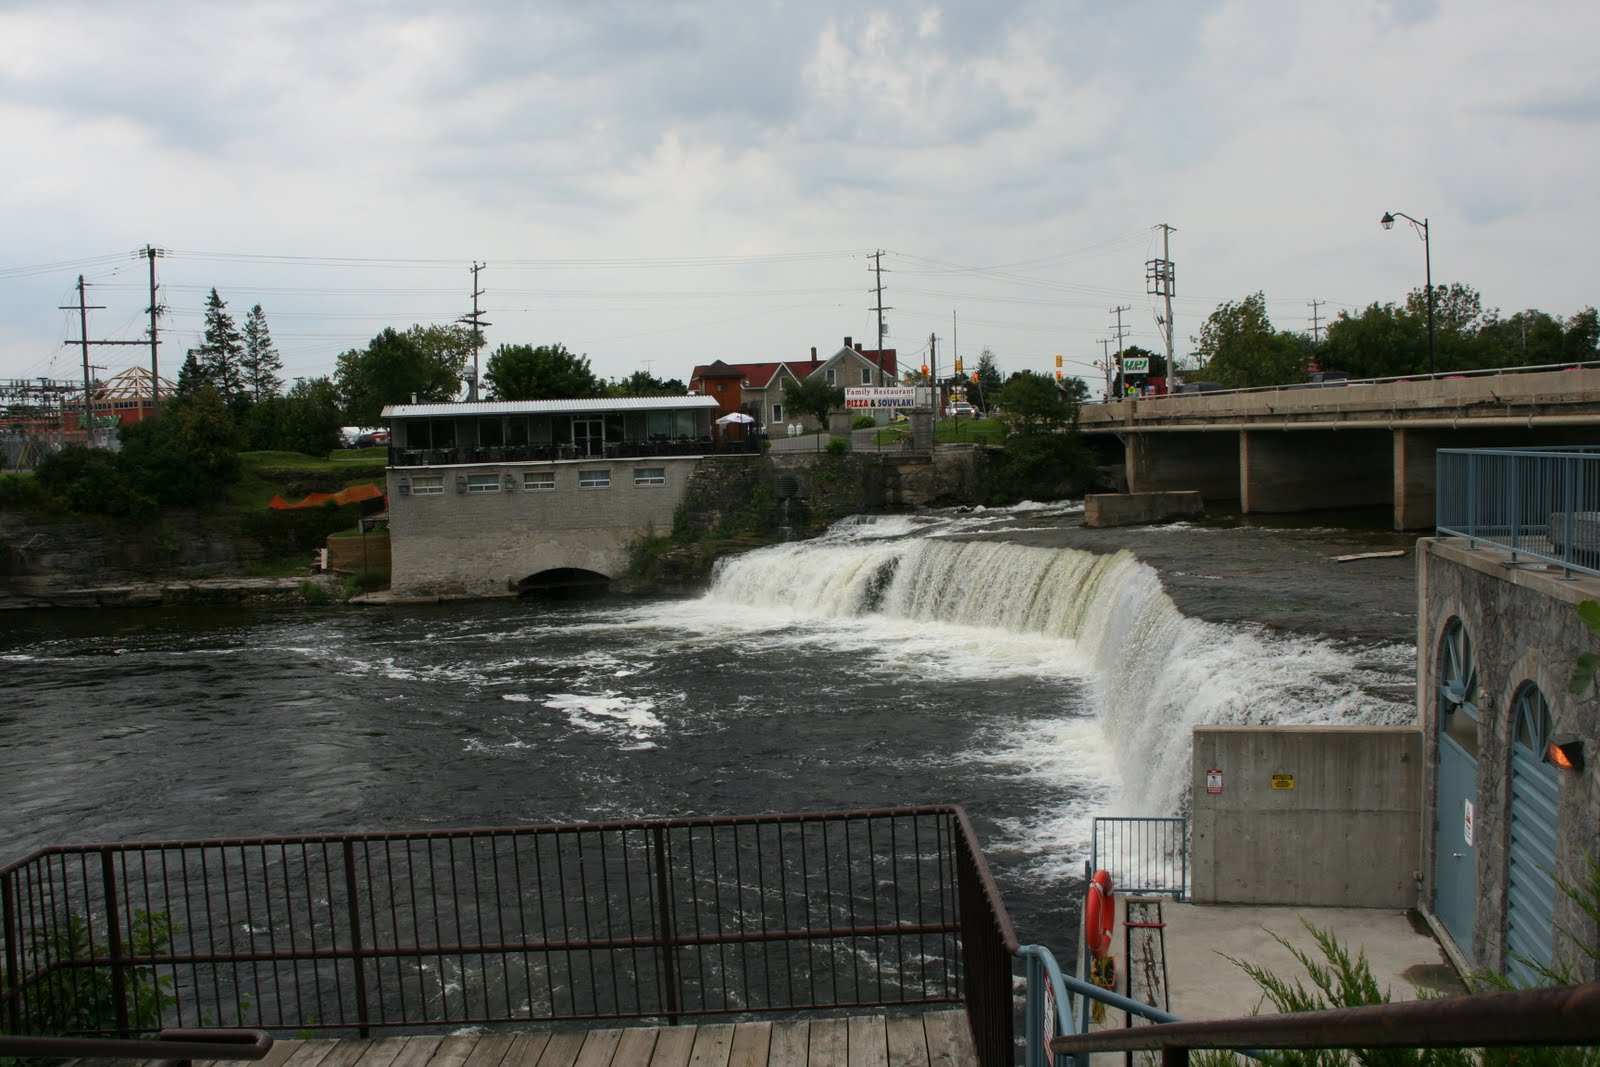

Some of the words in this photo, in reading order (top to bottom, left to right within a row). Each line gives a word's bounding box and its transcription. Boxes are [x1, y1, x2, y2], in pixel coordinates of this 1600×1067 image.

[1124, 360, 1148, 368] UPI
[846, 388, 870, 396] Family
[846, 399, 869, 407] PIZZA
[870, 399, 876, 407] &
[878, 399, 914, 407] SOUVLAKI
